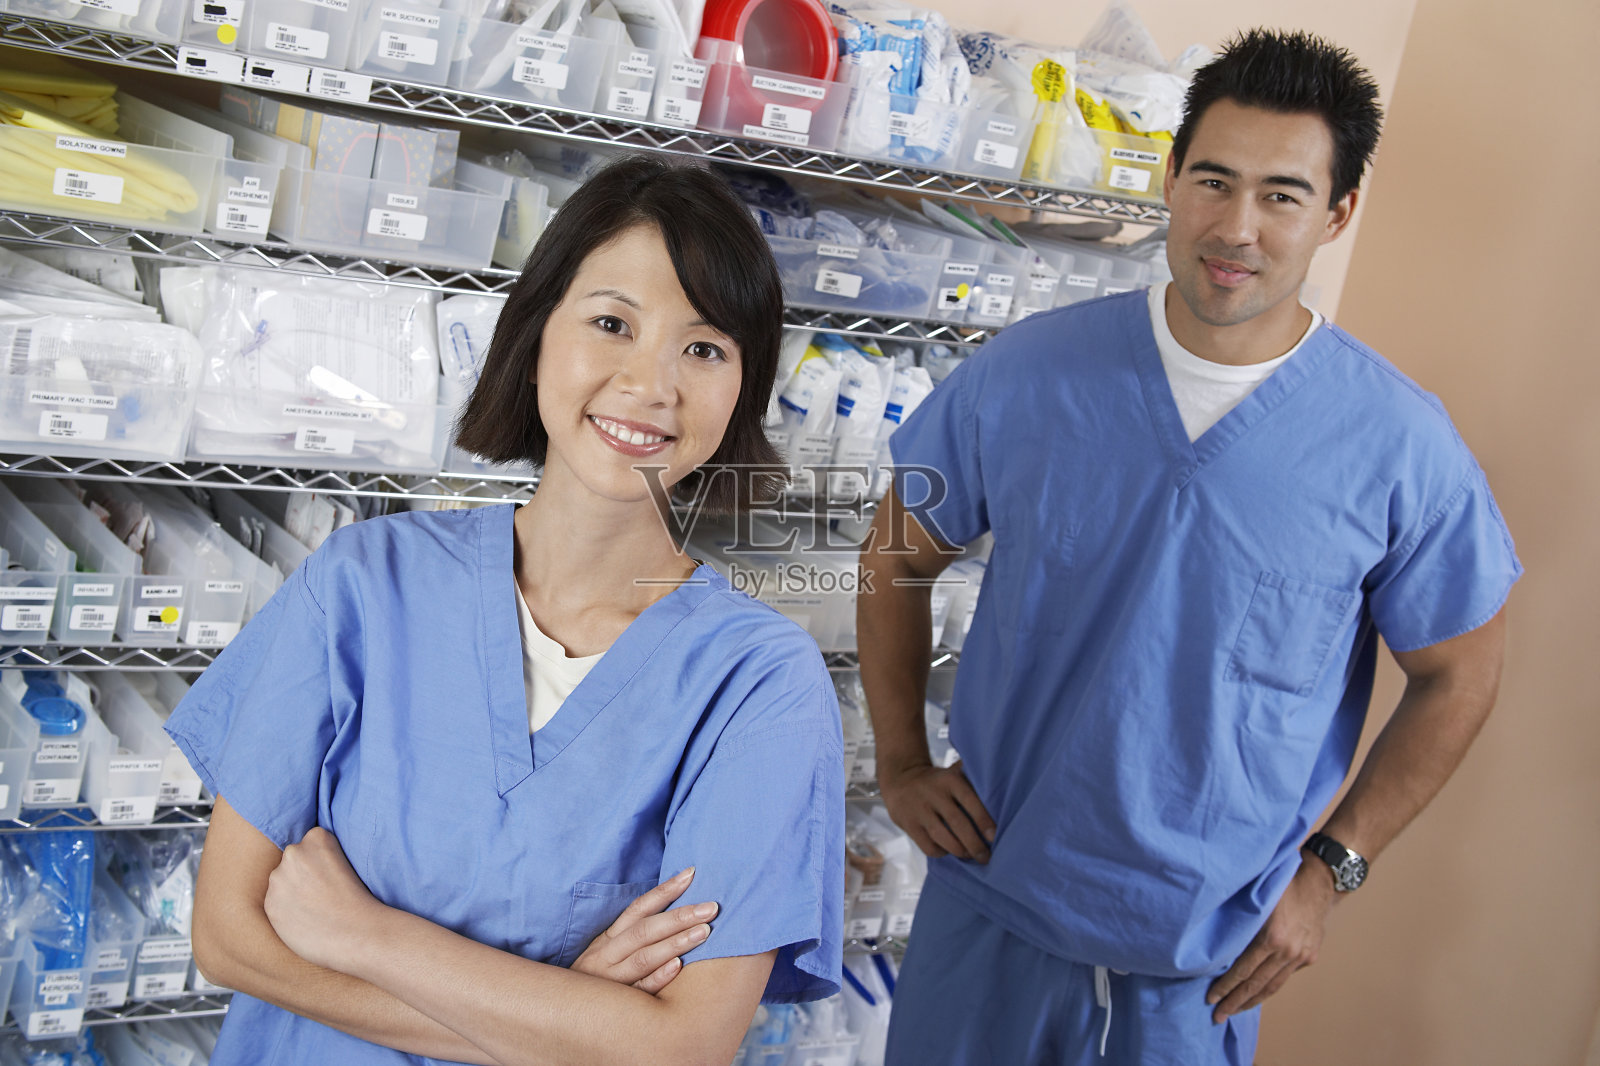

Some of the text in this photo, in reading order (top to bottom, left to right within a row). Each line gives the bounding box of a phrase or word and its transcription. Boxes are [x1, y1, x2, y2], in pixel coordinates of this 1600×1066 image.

[399, 13, 426, 24] SUCTION
[518, 36, 567, 50] SUCTION TUBING
[58, 138, 125, 155] ISOLATION GOWNS
[229, 190, 268, 200] FRESHENER
[31, 393, 65, 402] PRIMARY
[88, 398, 114, 406] TUBING
[285, 407, 322, 416] ANESTHESIA
